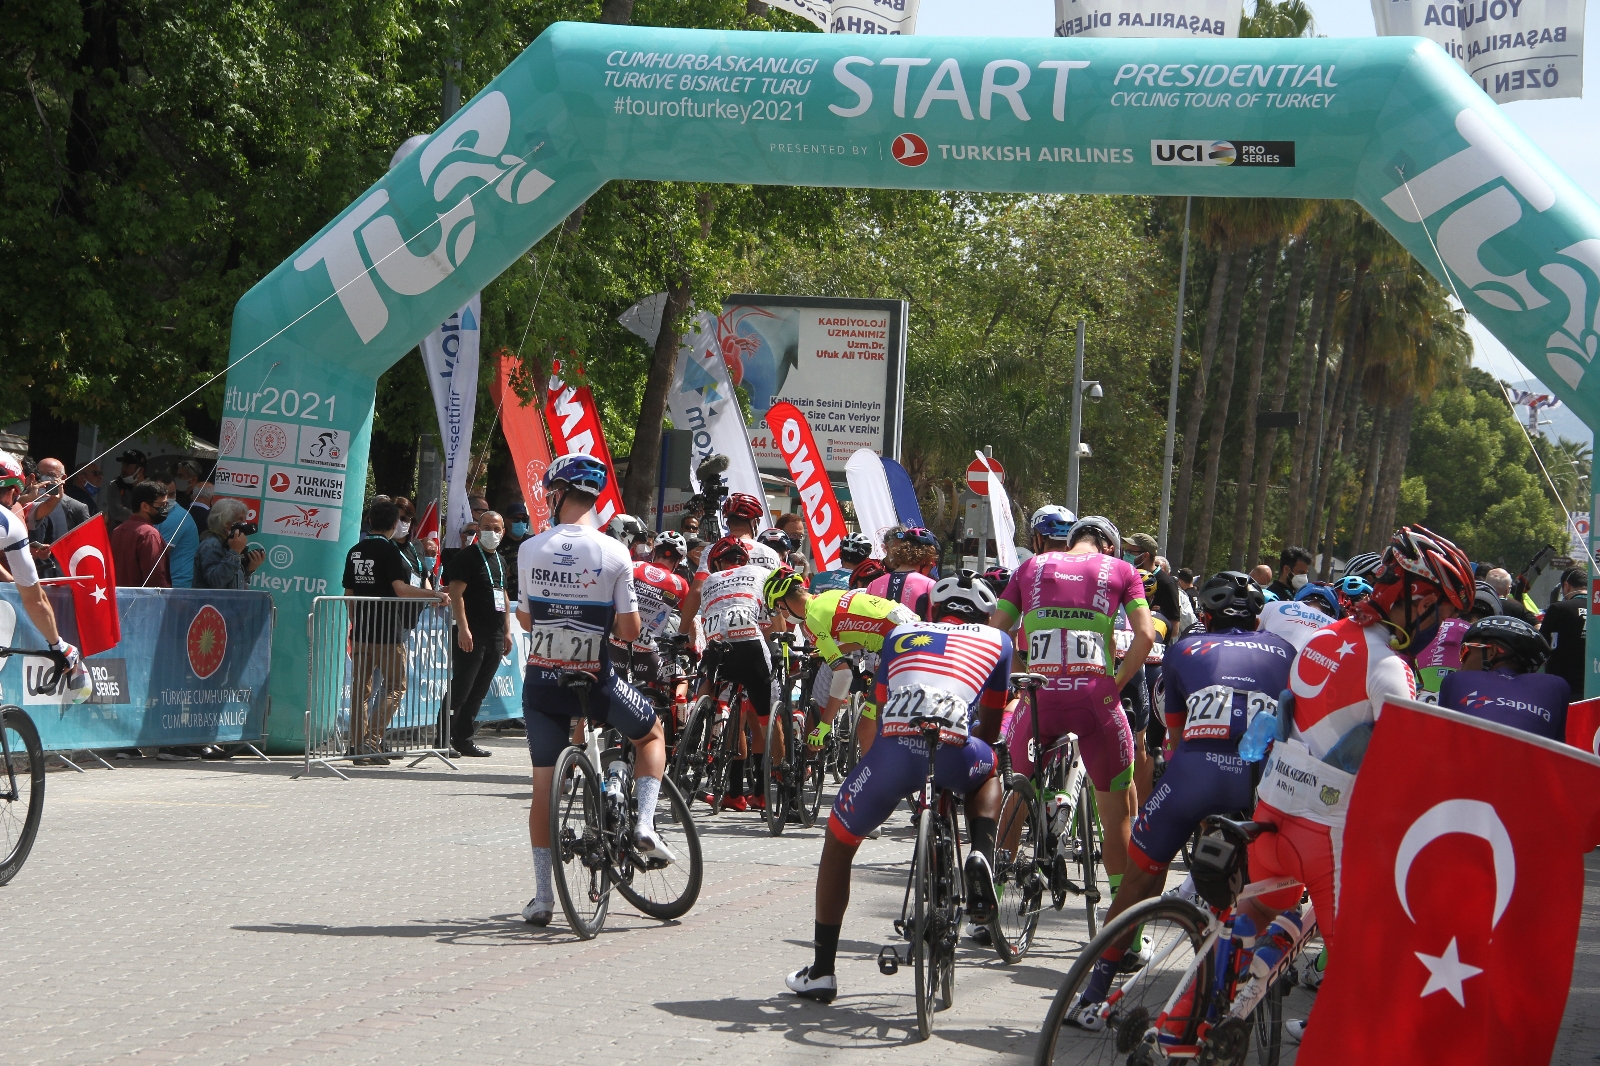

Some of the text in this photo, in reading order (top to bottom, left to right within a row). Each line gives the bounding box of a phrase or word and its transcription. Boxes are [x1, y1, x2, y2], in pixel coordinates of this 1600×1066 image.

[1113, 63, 1339, 88] PRESIDENTIAL
[761, 77, 812, 96] TURU
[827, 55, 1091, 122] START
[1110, 91, 1336, 109] CYCLING TOUR OF TURKEY
[614, 95, 804, 125] #tourofturkey2021
[770, 143, 868, 156] PRESENTED BY
[938, 144, 1134, 164] TURKISH AIRLINES
[1156, 144, 1265, 163] UCI PRO
[1242, 154, 1280, 164] SERIES
[818, 316, 888, 329] KARDİYOLOJİ
[827, 329, 887, 339] UZMANIMIZ
[816, 350, 839, 360] Ufuk
[857, 349, 885, 361] TÜRK
[816, 398, 843, 409] Sesini
[844, 400, 881, 411] Dinleyin
[807, 410, 881, 423] Size Can Veriyor
[814, 423, 847, 434] KULAK
[297, 475, 343, 490] TURKISH
[294, 485, 342, 500] AIRLINES
[1063, 554, 1097, 563] CSF
[531, 568, 574, 584] ISRAEL
[533, 631, 554, 658] 21
[570, 636, 593, 662] 21
[1030, 633, 1052, 660] 67
[1076, 635, 1097, 660] 67
[91, 666, 109, 681] PRO
[96, 681, 120, 697] SERIES
[884, 688, 926, 718] 222
[1187, 691, 1230, 724] 227
[1185, 728, 1228, 738] SALCANO
[911, 748, 930, 758] energ
[1220, 765, 1243, 774] energy
